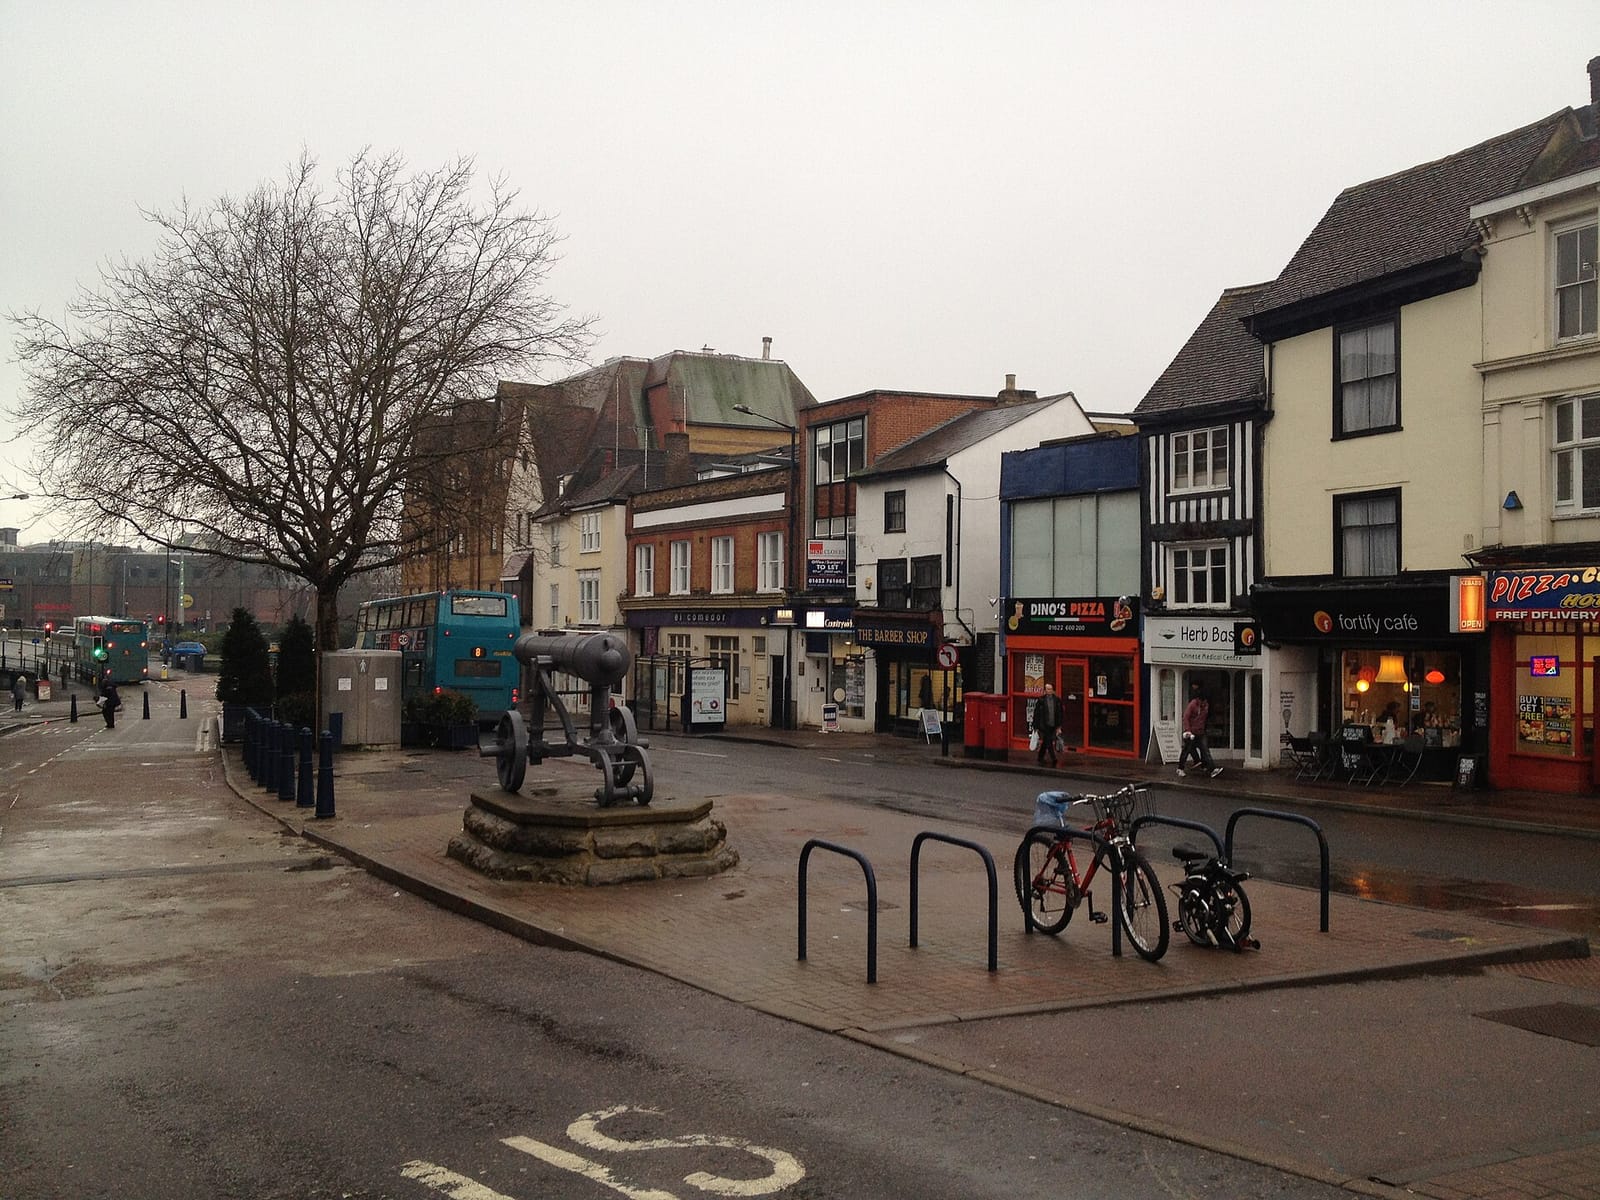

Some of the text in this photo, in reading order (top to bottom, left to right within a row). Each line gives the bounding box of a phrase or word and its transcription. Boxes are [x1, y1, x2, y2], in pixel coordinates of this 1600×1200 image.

[1492, 574, 1570, 602] PIZZA
[1030, 603, 1105, 616] DINO'S PIZZA
[1339, 613, 1419, 634] fortify café
[1461, 620, 1482, 628] OPEN
[858, 629, 928, 644] THE BARBER SHOP
[1181, 626, 1235, 642] Herb Bas
[399, 636, 408, 644] 20
[475, 647, 481, 657] 8
[1026, 664, 1042, 672] FREE
[1520, 696, 1537, 704] BUY
[1540, 697, 1544, 705] 1
[1520, 704, 1544, 713] GET 1
[1520, 712, 1544, 720] FREE!
